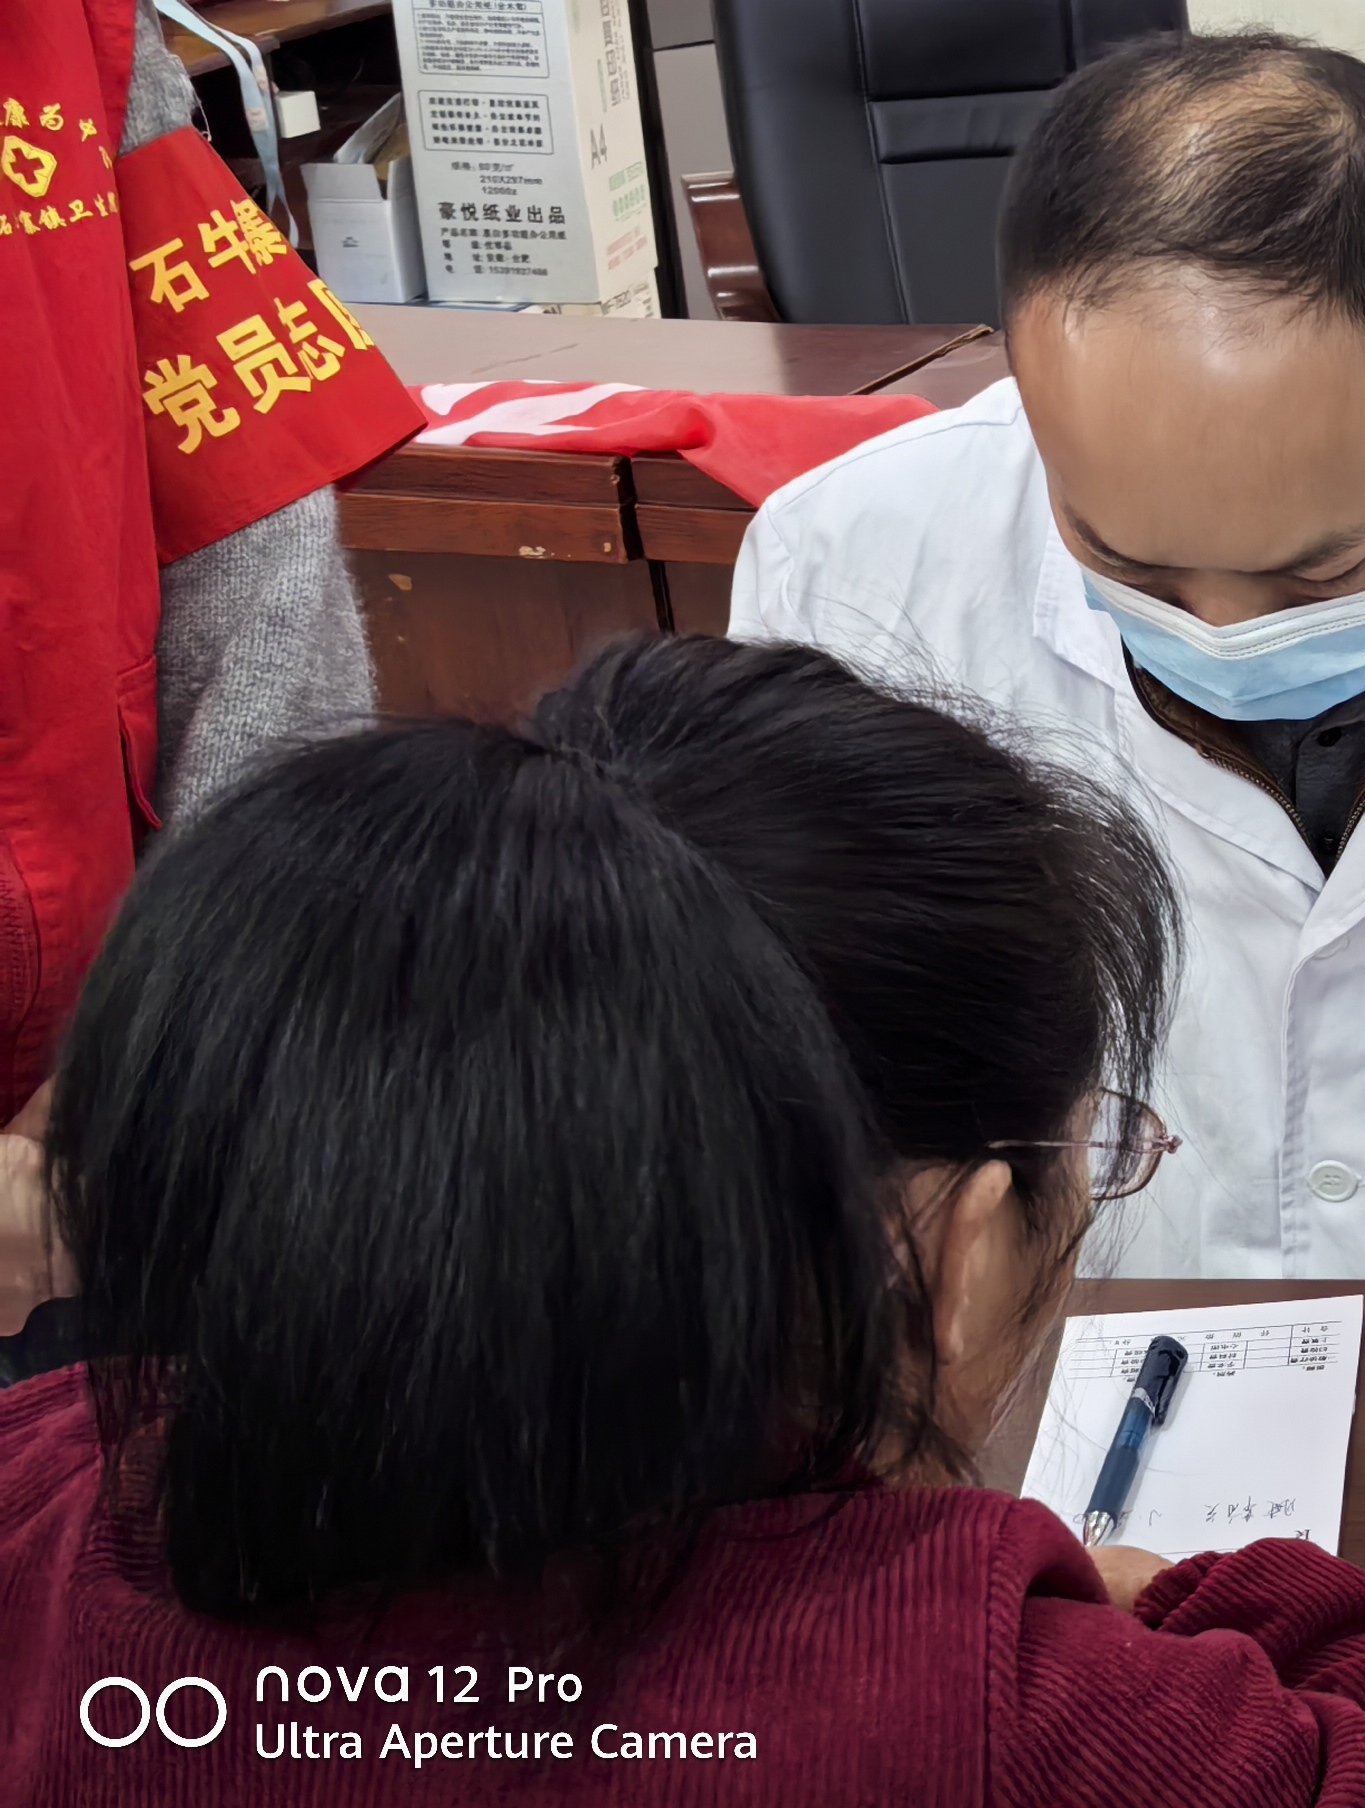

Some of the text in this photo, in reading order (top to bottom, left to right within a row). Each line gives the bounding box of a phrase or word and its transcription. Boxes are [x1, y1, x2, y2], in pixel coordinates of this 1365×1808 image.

[590, 123, 608, 170] A4
[438, 202, 566, 224] 豪悦纸业出品
